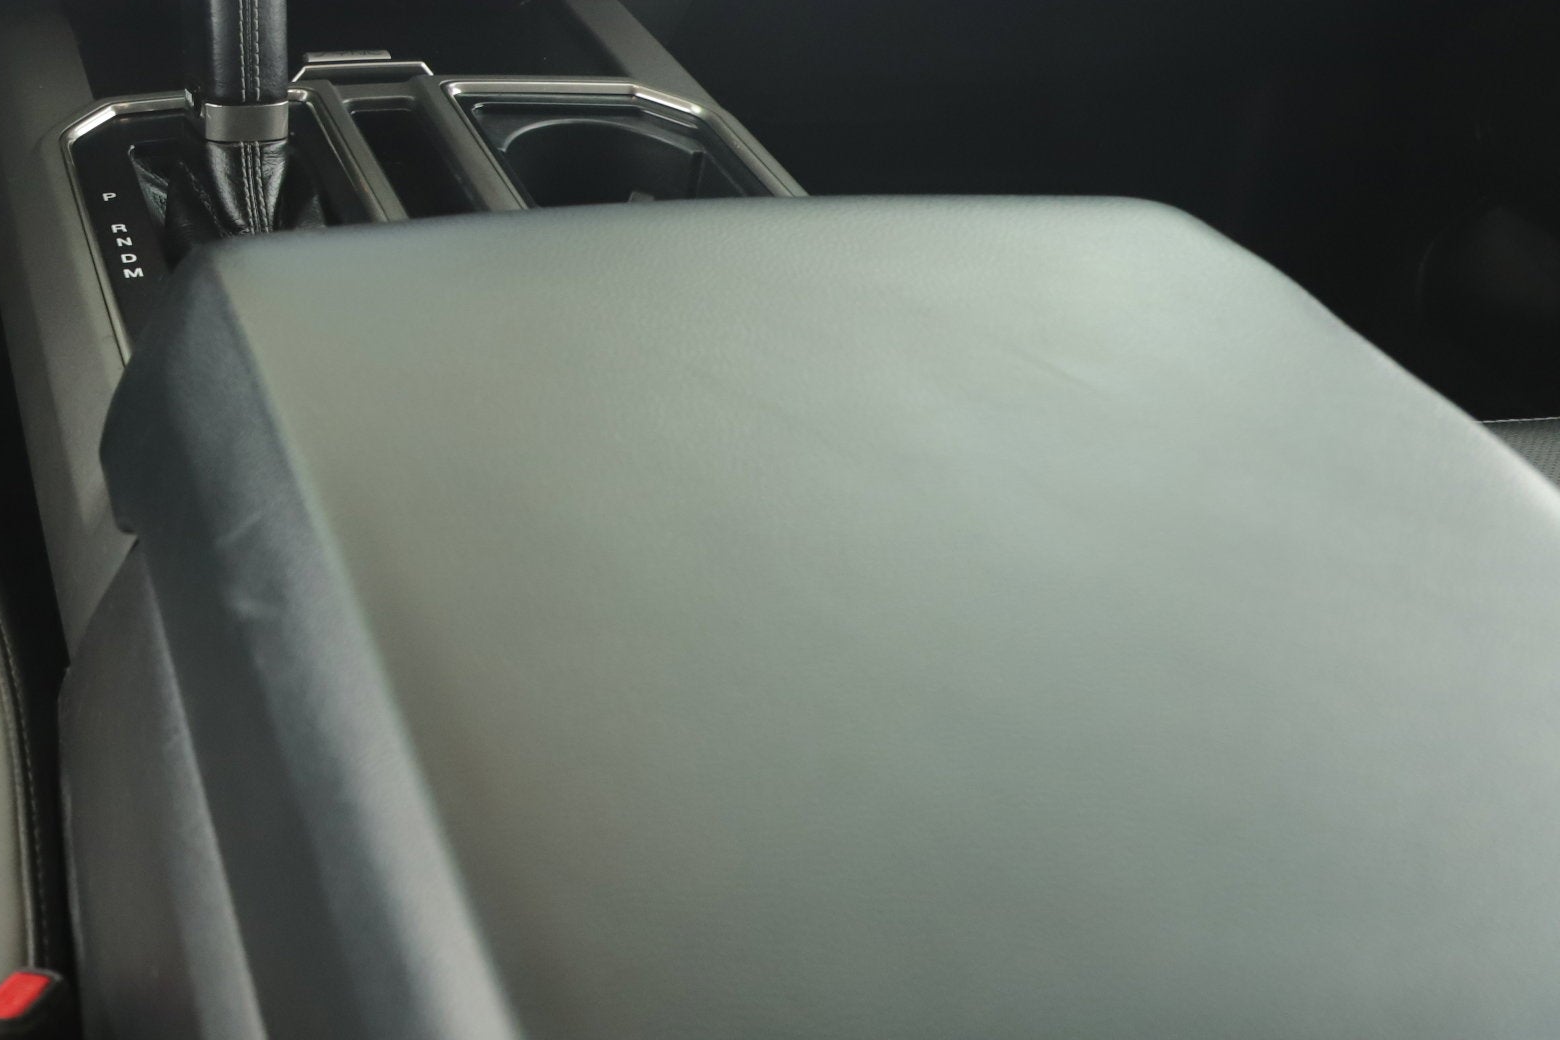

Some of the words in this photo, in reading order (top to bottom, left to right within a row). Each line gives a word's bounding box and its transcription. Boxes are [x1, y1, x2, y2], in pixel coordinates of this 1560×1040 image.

[102, 192, 117, 201] P
[111, 224, 127, 233] R
[116, 237, 133, 247] N
[120, 253, 137, 263] D
[123, 267, 144, 279] M
